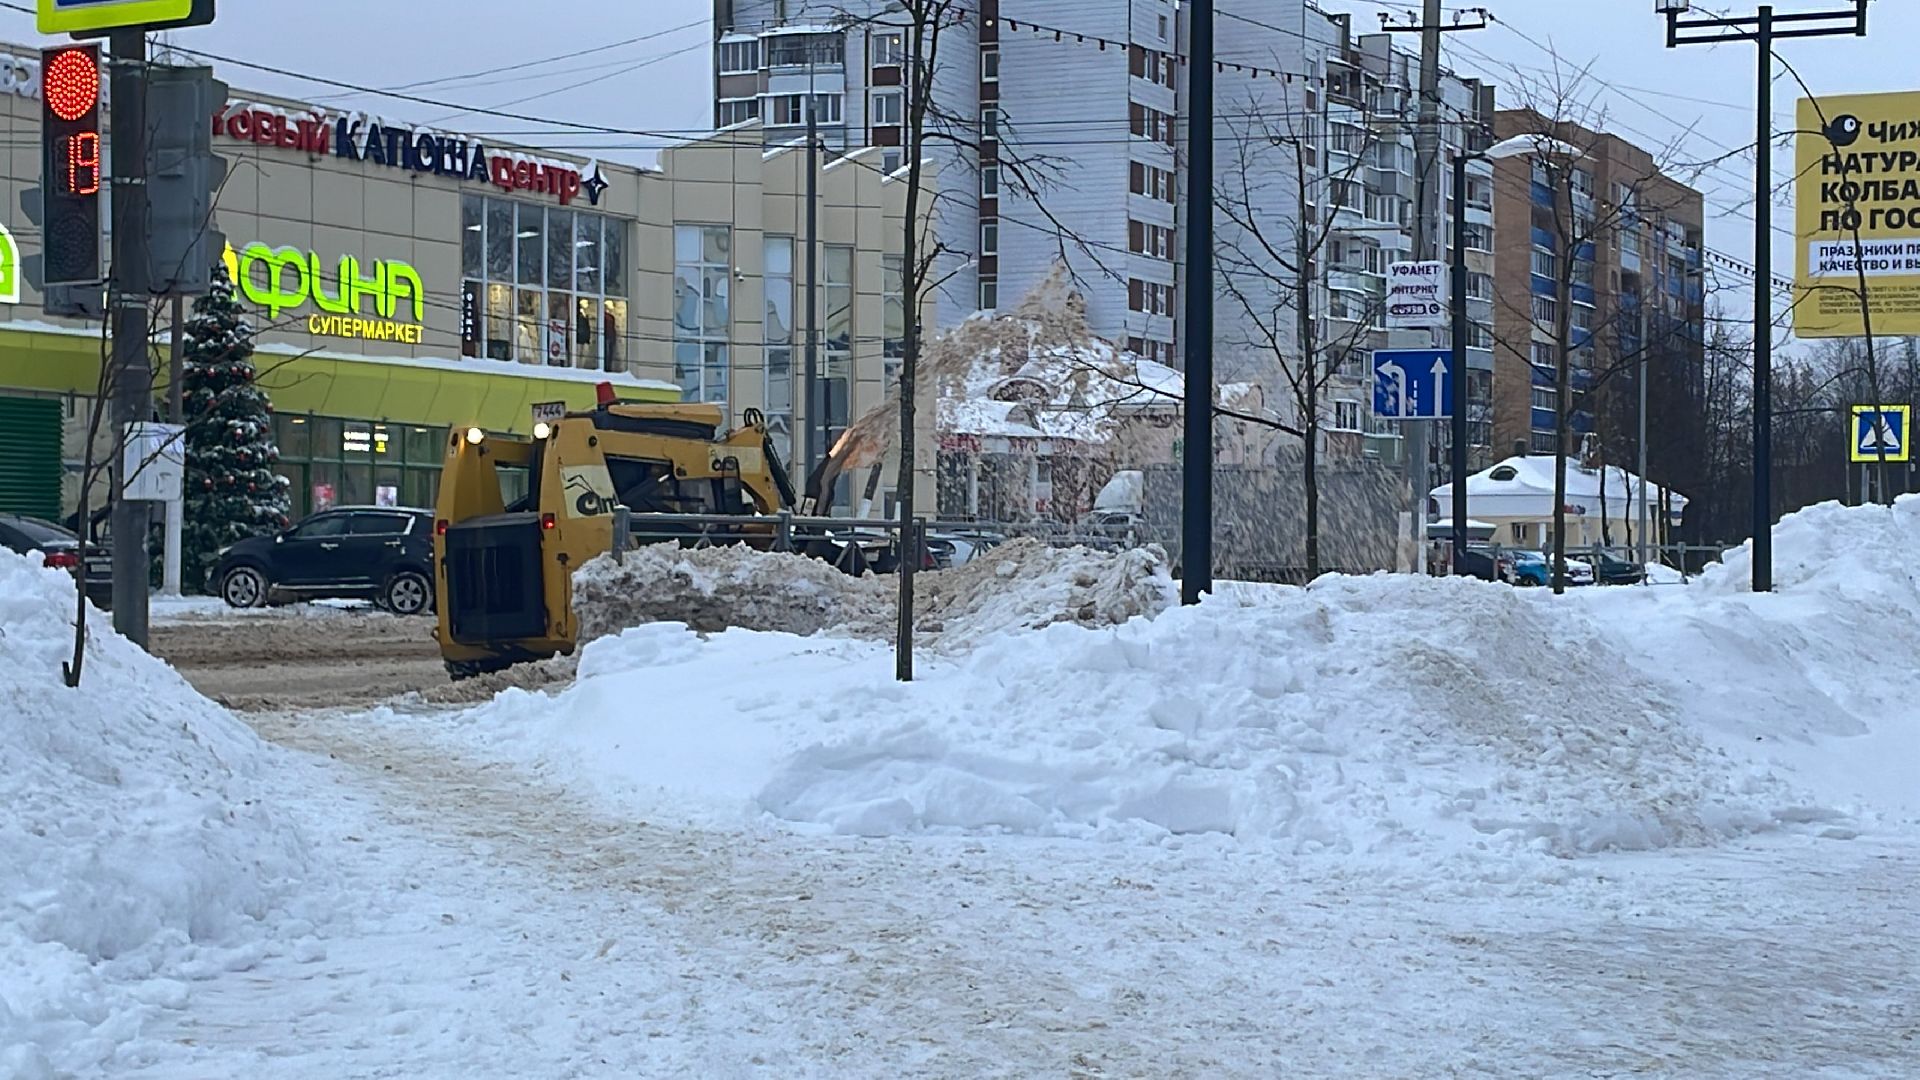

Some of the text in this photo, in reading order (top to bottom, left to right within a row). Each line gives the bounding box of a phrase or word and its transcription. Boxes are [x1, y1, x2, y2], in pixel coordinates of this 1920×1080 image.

[336, 116, 492, 184] КАТЮША
[69, 133, 99, 194] 19
[1822, 151, 1920, 175] НАТУР
[1821, 179, 1920, 203] КОЛБА
[1821, 207, 1920, 231] ПО ГОС
[1392, 264, 1439, 276] УФАНЕТ
[1820, 259, 1889, 271] КАЧЕСТВО
[1892, 260, 1901, 269] И
[1391, 285, 1438, 295] ИНТЕРНЕТ
[309, 314, 424, 344] СУПЕРМАРКЕТ
